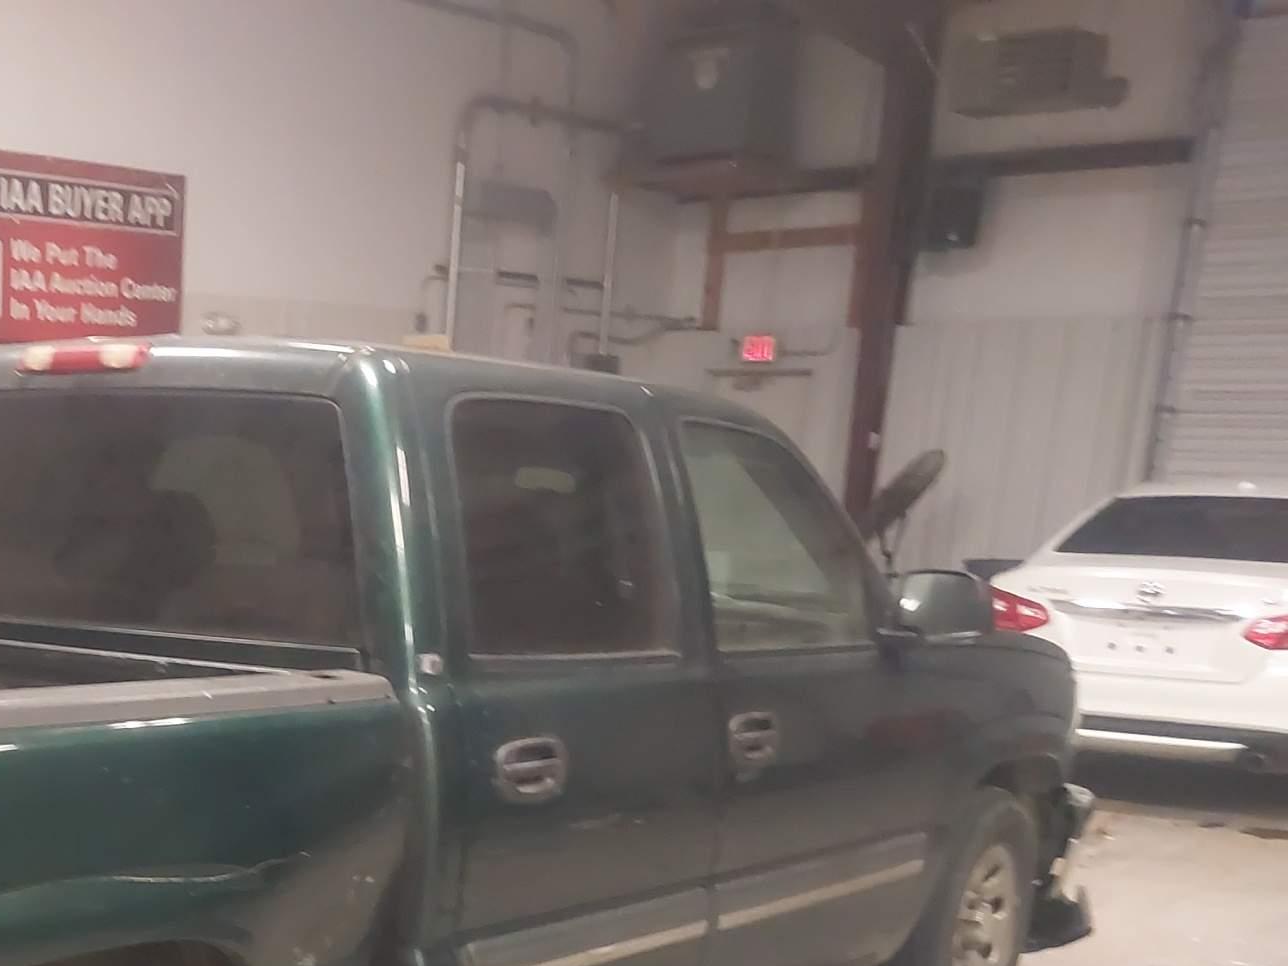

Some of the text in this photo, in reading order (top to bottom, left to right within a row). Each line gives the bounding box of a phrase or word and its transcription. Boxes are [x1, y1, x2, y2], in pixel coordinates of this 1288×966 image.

[0, 177, 44, 214] IAA
[47, 182, 124, 223] BUYER
[127, 194, 173, 227] APP
[10, 238, 118, 271] We Put The
[10, 268, 48, 293] IAA
[49, 272, 119, 298] Auction
[120, 277, 177, 302] Center
[10, 297, 137, 327] In Your Hands
